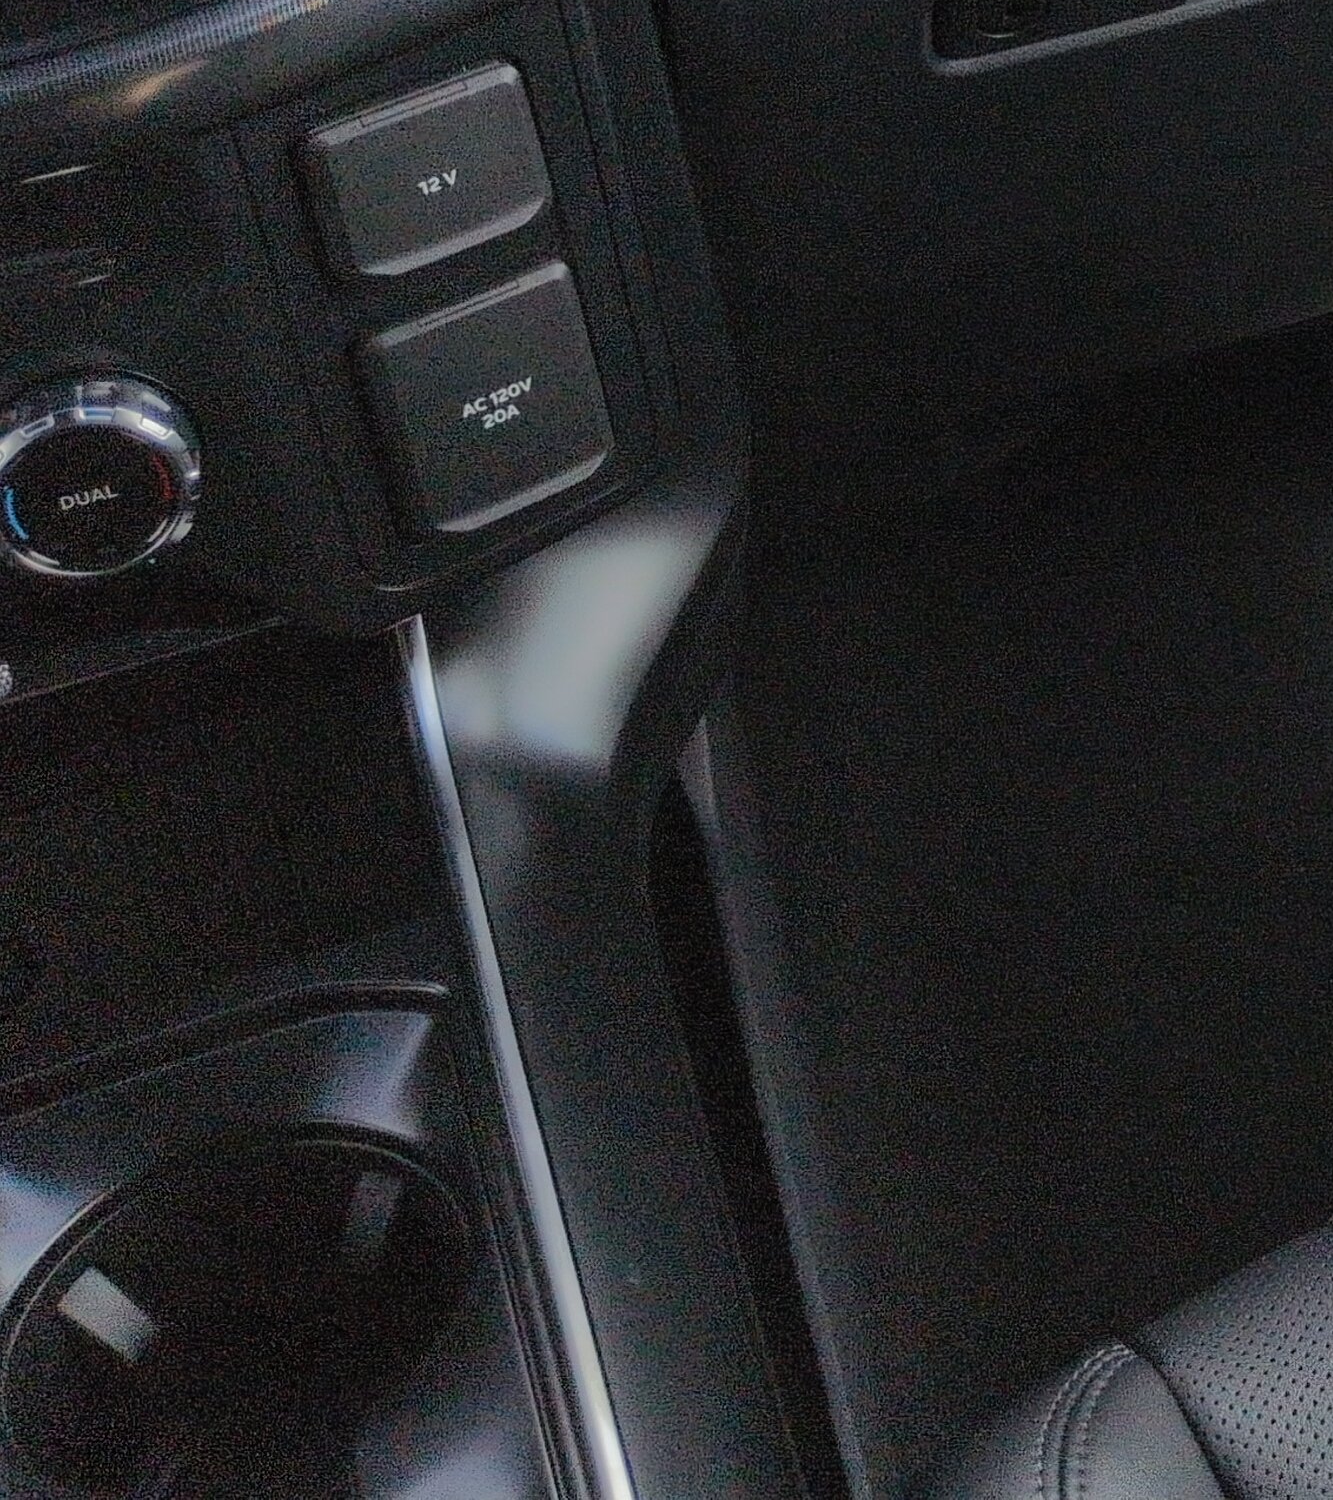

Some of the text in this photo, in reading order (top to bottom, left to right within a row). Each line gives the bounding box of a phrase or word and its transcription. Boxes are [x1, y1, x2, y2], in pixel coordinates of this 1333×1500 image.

[463, 376, 532, 418] AC 120V
[481, 404, 520, 429] 20A
[60, 485, 119, 510] DUAL
